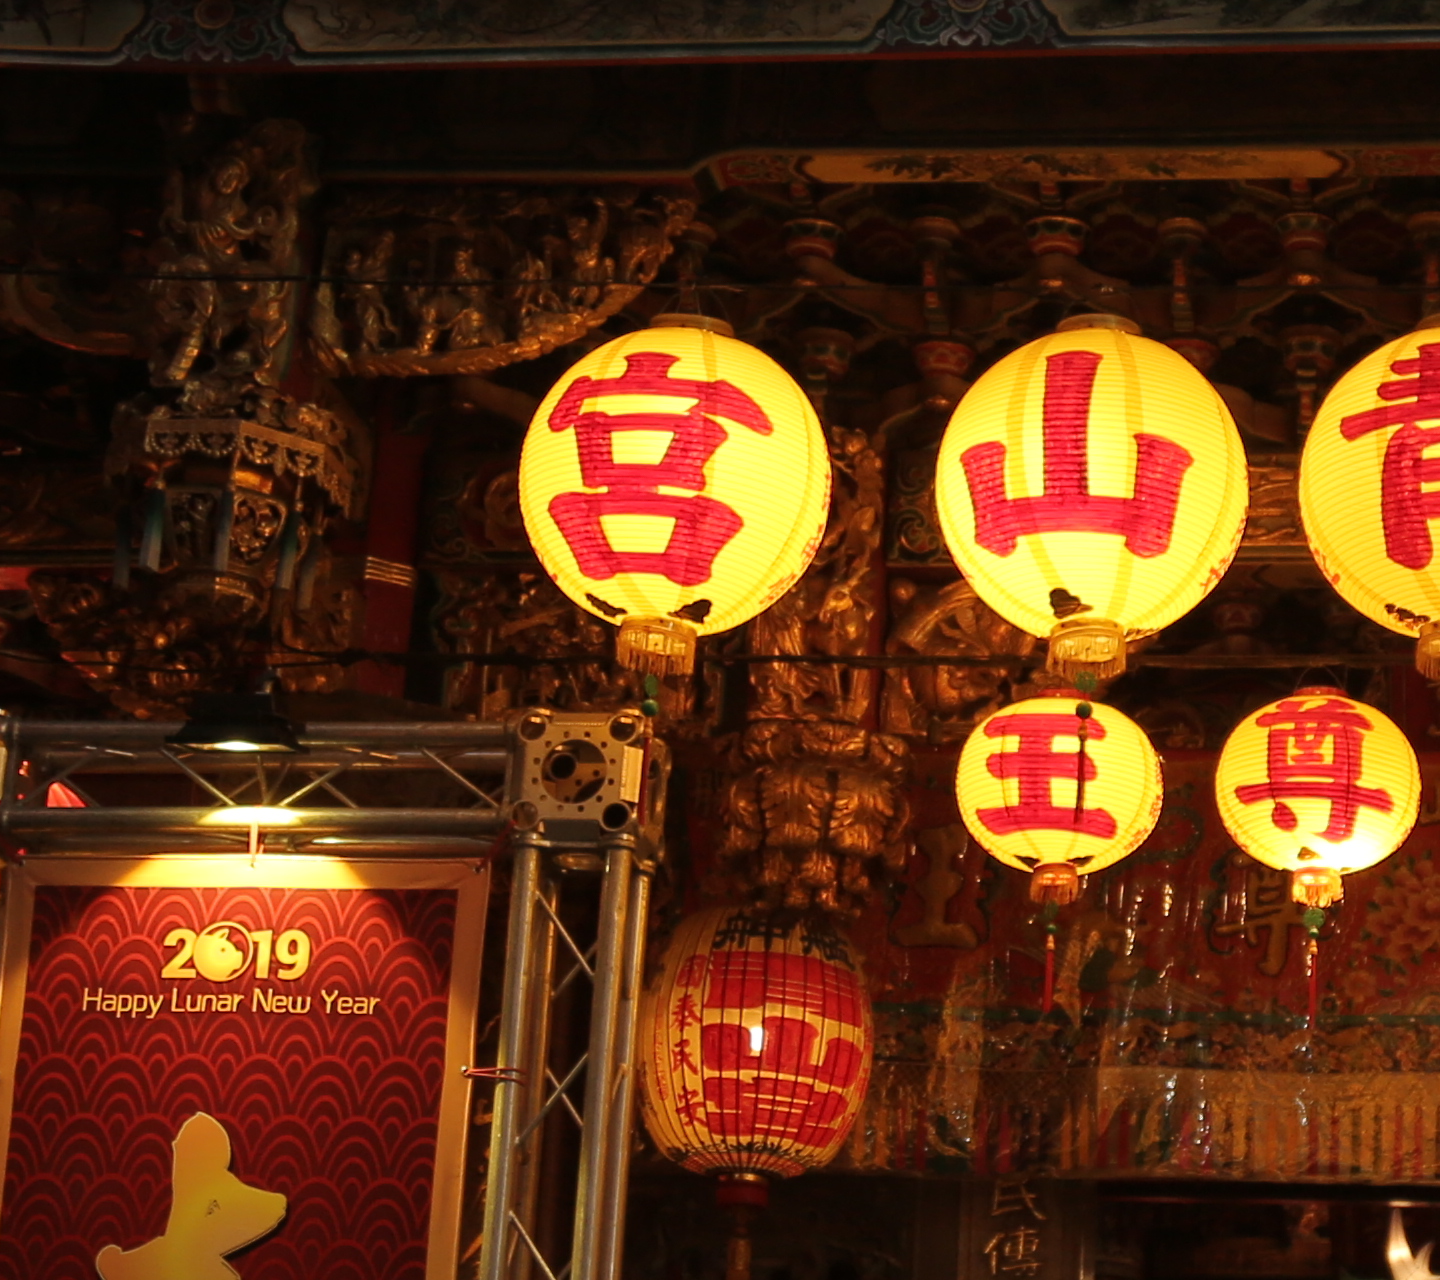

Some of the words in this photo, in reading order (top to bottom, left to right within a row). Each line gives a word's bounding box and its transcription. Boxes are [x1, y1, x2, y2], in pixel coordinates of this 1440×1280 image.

[161, 921, 311, 983] 2019
[82, 988, 164, 1019] Happy
[171, 988, 245, 1013] Lunar
[252, 988, 312, 1013] New
[321, 989, 381, 1015] Year
